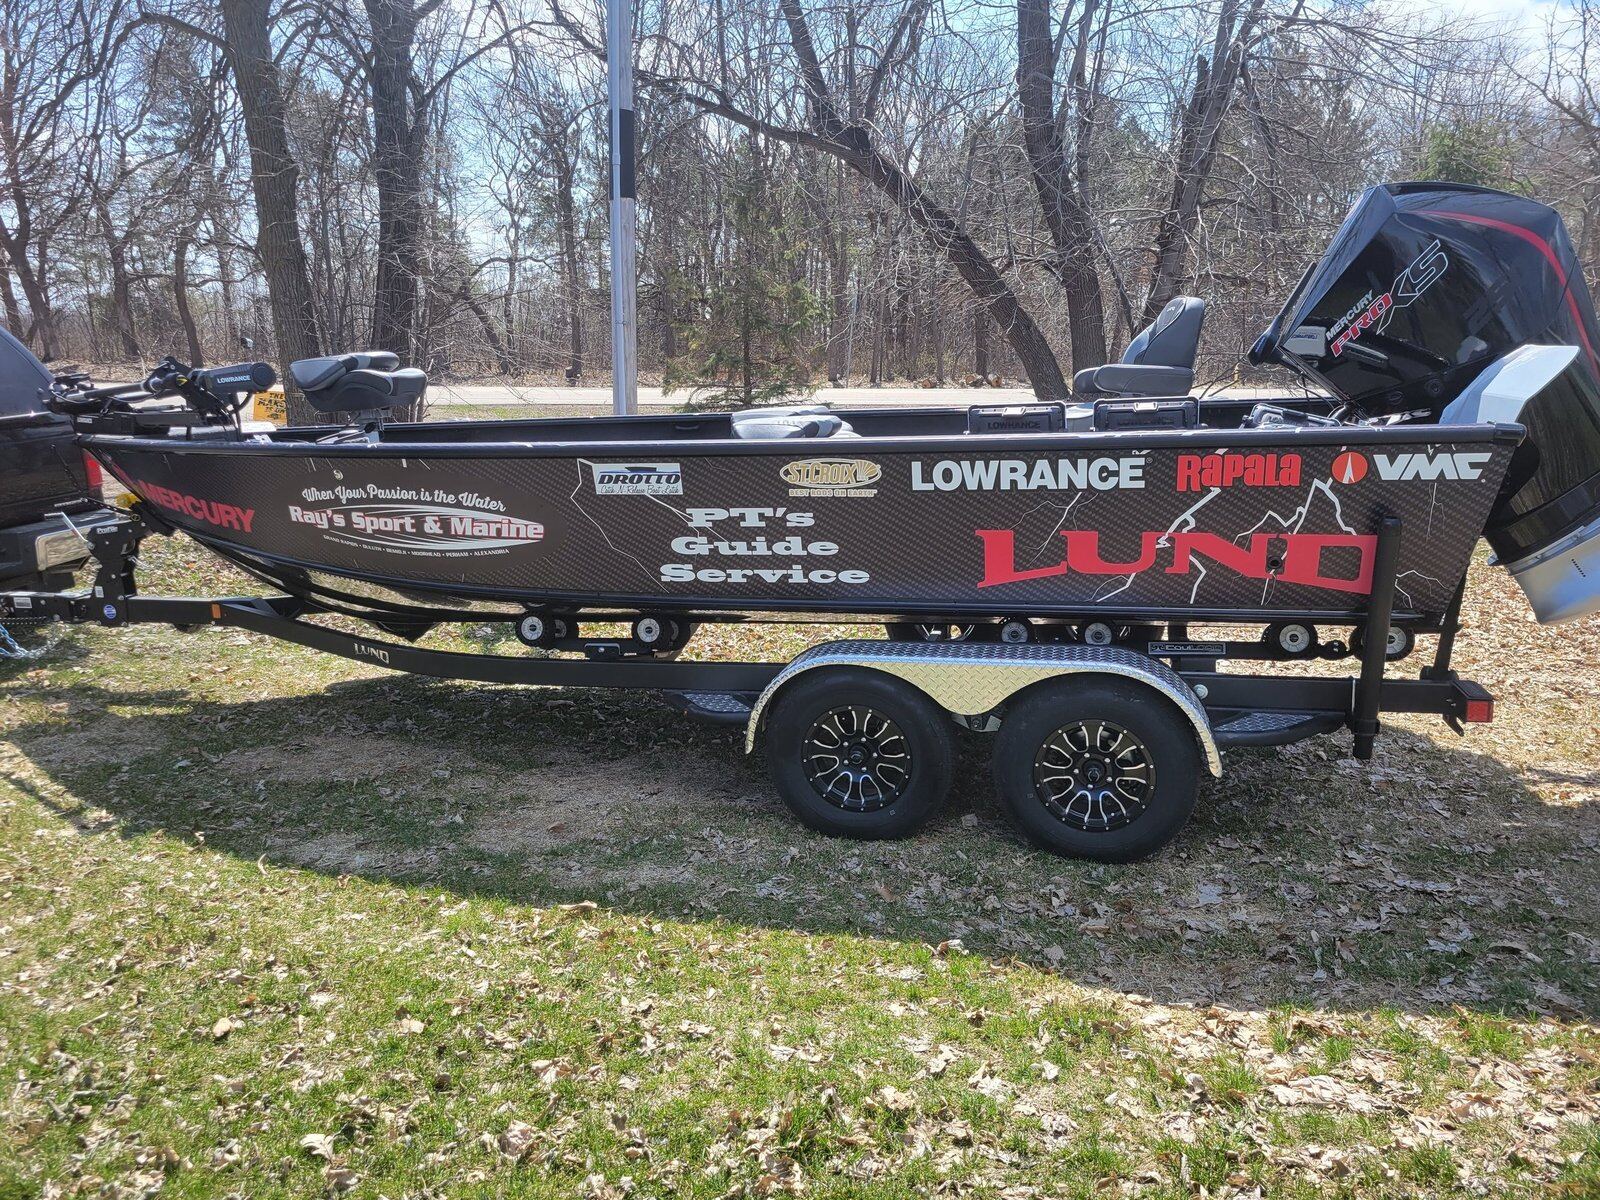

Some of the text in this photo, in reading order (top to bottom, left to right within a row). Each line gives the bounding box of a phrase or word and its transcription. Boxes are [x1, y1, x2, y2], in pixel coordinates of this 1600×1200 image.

[1331, 292, 1393, 357] PRO
[1376, 239, 1449, 335] XS
[1326, 290, 1373, 341] MERCURY
[217, 374, 251, 384] LOWRANCE
[987, 420, 1041, 430] LOWRANCE
[911, 457, 1146, 491] LOWRANCE
[1373, 452, 1492, 481] VMC
[598, 474, 681, 485] DROTTO
[302, 484, 507, 512] When Your Passion is the Water
[789, 488, 810, 497] BEST
[810, 488, 833, 497] RODS
[834, 488, 847, 497] ON
[137, 480, 255, 533] MERCURY
[686, 508, 815, 527] PT's
[288, 505, 545, 540] Ray's Sport & Marine
[323, 534, 340, 544] GRAND
[410, 550, 441, 558] MOORHEAD
[445, 550, 469, 558] PERHAM
[473, 548, 510, 557] ALEXANDRIA
[670, 536, 840, 556] Guide
[660, 564, 871, 584] Service
[975, 530, 1378, 595] LUND
[354, 642, 390, 665] LUND
